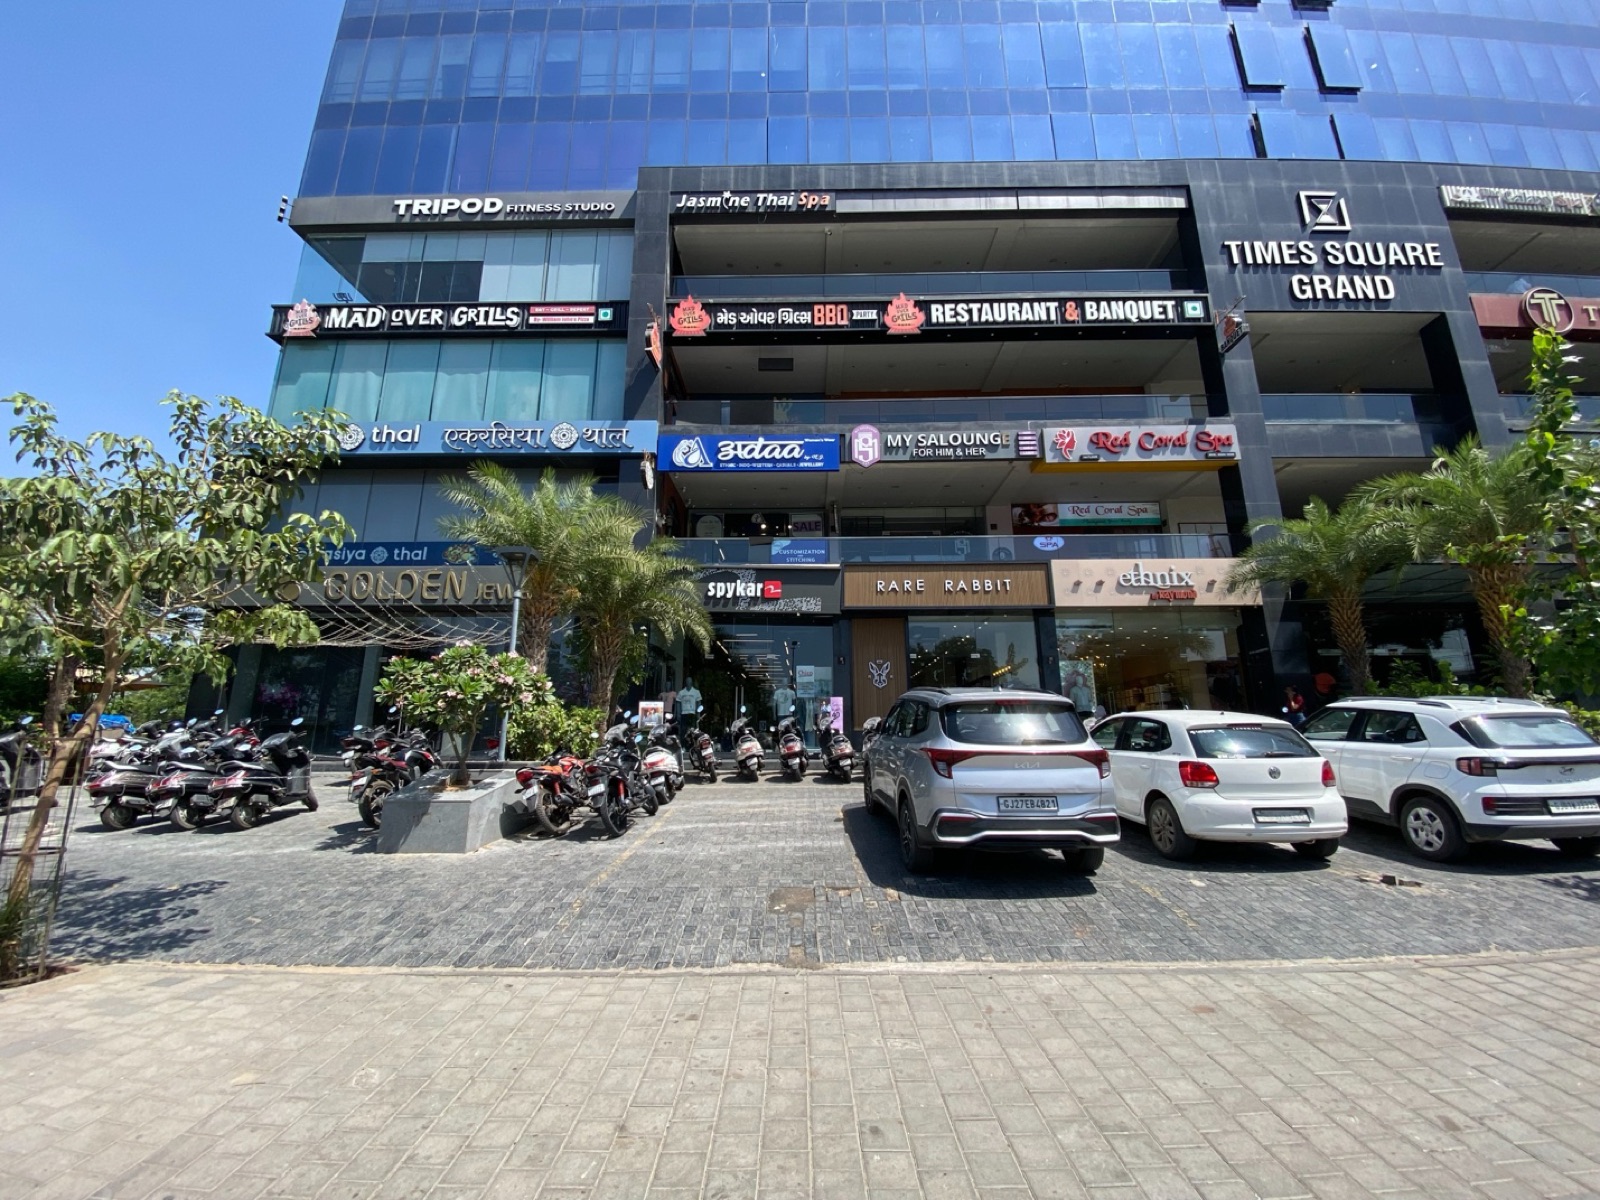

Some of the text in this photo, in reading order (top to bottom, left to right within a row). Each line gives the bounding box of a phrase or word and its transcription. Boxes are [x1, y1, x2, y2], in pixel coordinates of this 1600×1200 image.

[394, 197, 615, 216] TRIPOD FITNESS STUDIO
[756, 192, 795, 206] Thai
[798, 192, 830, 208] Spa
[1224, 241, 1444, 267] TIMES SQUARE
[1291, 274, 1395, 300] GRAND
[327, 307, 381, 328] MAD
[391, 309, 443, 326] OVER
[452, 306, 520, 328] GRILLS
[716, 308, 737, 325] મેડ
[739, 308, 776, 325] ઓવર
[813, 304, 849, 326] BBQ
[855, 311, 874, 319] PARTY
[931, 300, 1175, 323] RESTAURANT & BANQUET
[371, 424, 421, 443] thal
[582, 427, 634, 448] थाल
[887, 434, 913, 447] MY
[917, 432, 1010, 447] SALOUNGE
[1090, 431, 1131, 453] Red
[1196, 431, 1234, 452] Spa
[913, 447, 986, 457] FOR HIM & HER
[1068, 505, 1148, 517] Red Coral Spa
[793, 521, 821, 532] SALE
[393, 547, 428, 560] thal
[324, 570, 468, 600] GOLDEN
[1119, 562, 1195, 589] ethnix
[707, 580, 763, 598] spykar
[877, 579, 1011, 592] RARE RABBIT
